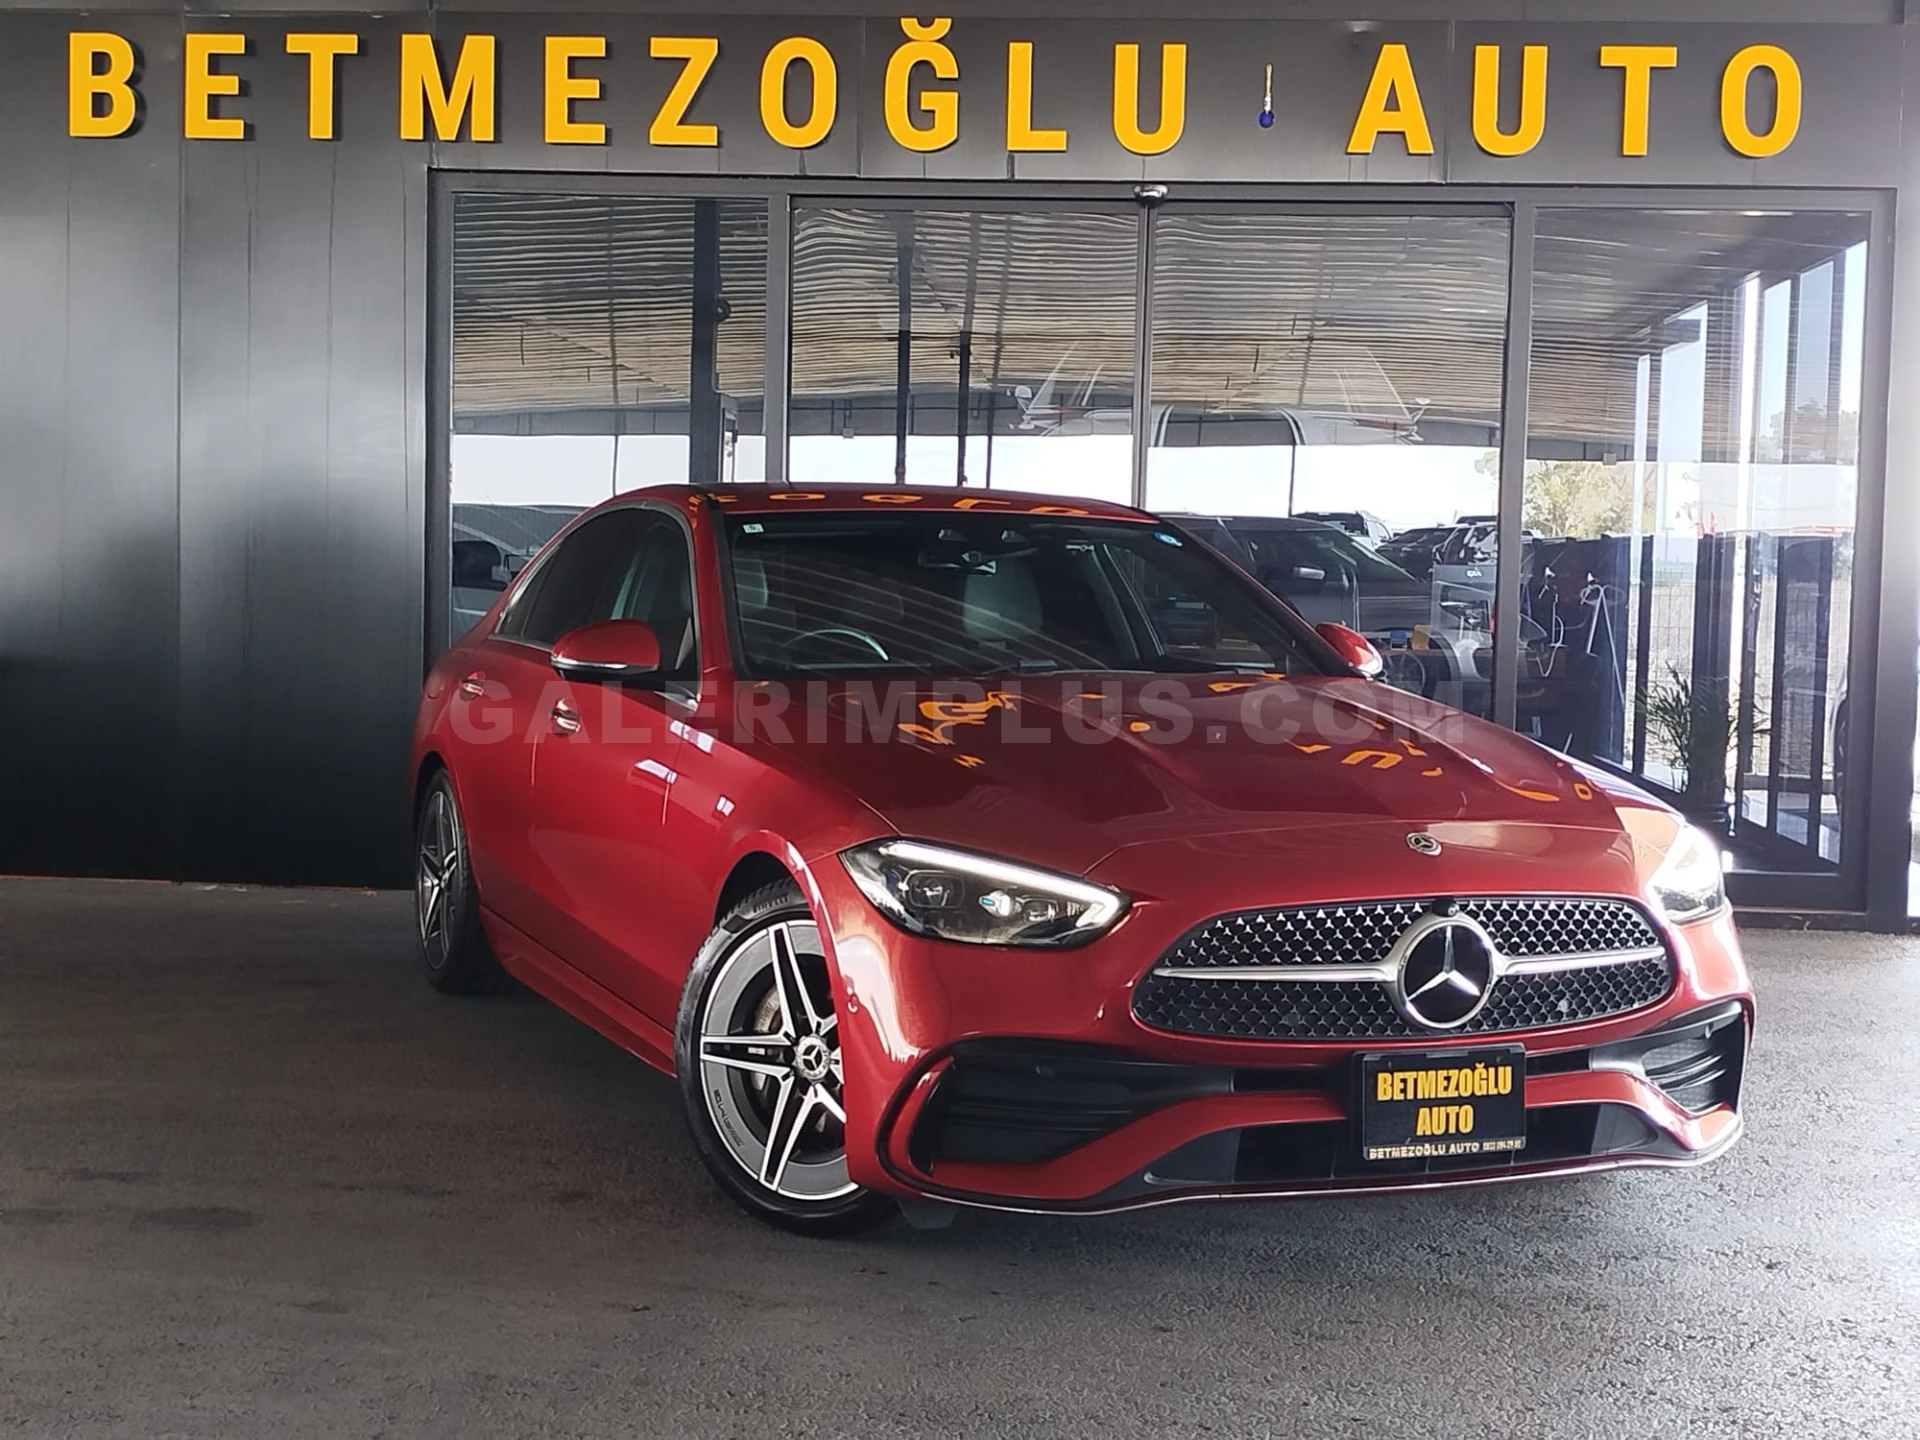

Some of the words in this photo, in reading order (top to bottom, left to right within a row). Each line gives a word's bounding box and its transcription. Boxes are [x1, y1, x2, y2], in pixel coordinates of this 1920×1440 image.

[67, 17, 1188, 155] BETMEZOĞLU
[1346, 43, 1803, 158] AUTO
[1376, 1062, 1512, 1101] BETMEZOĞLU
[1416, 1104, 1475, 1136] AUTO
[1368, 1143, 1446, 1160] BETMEZOĞLU
[1449, 1142, 1480, 1155] AUTO
